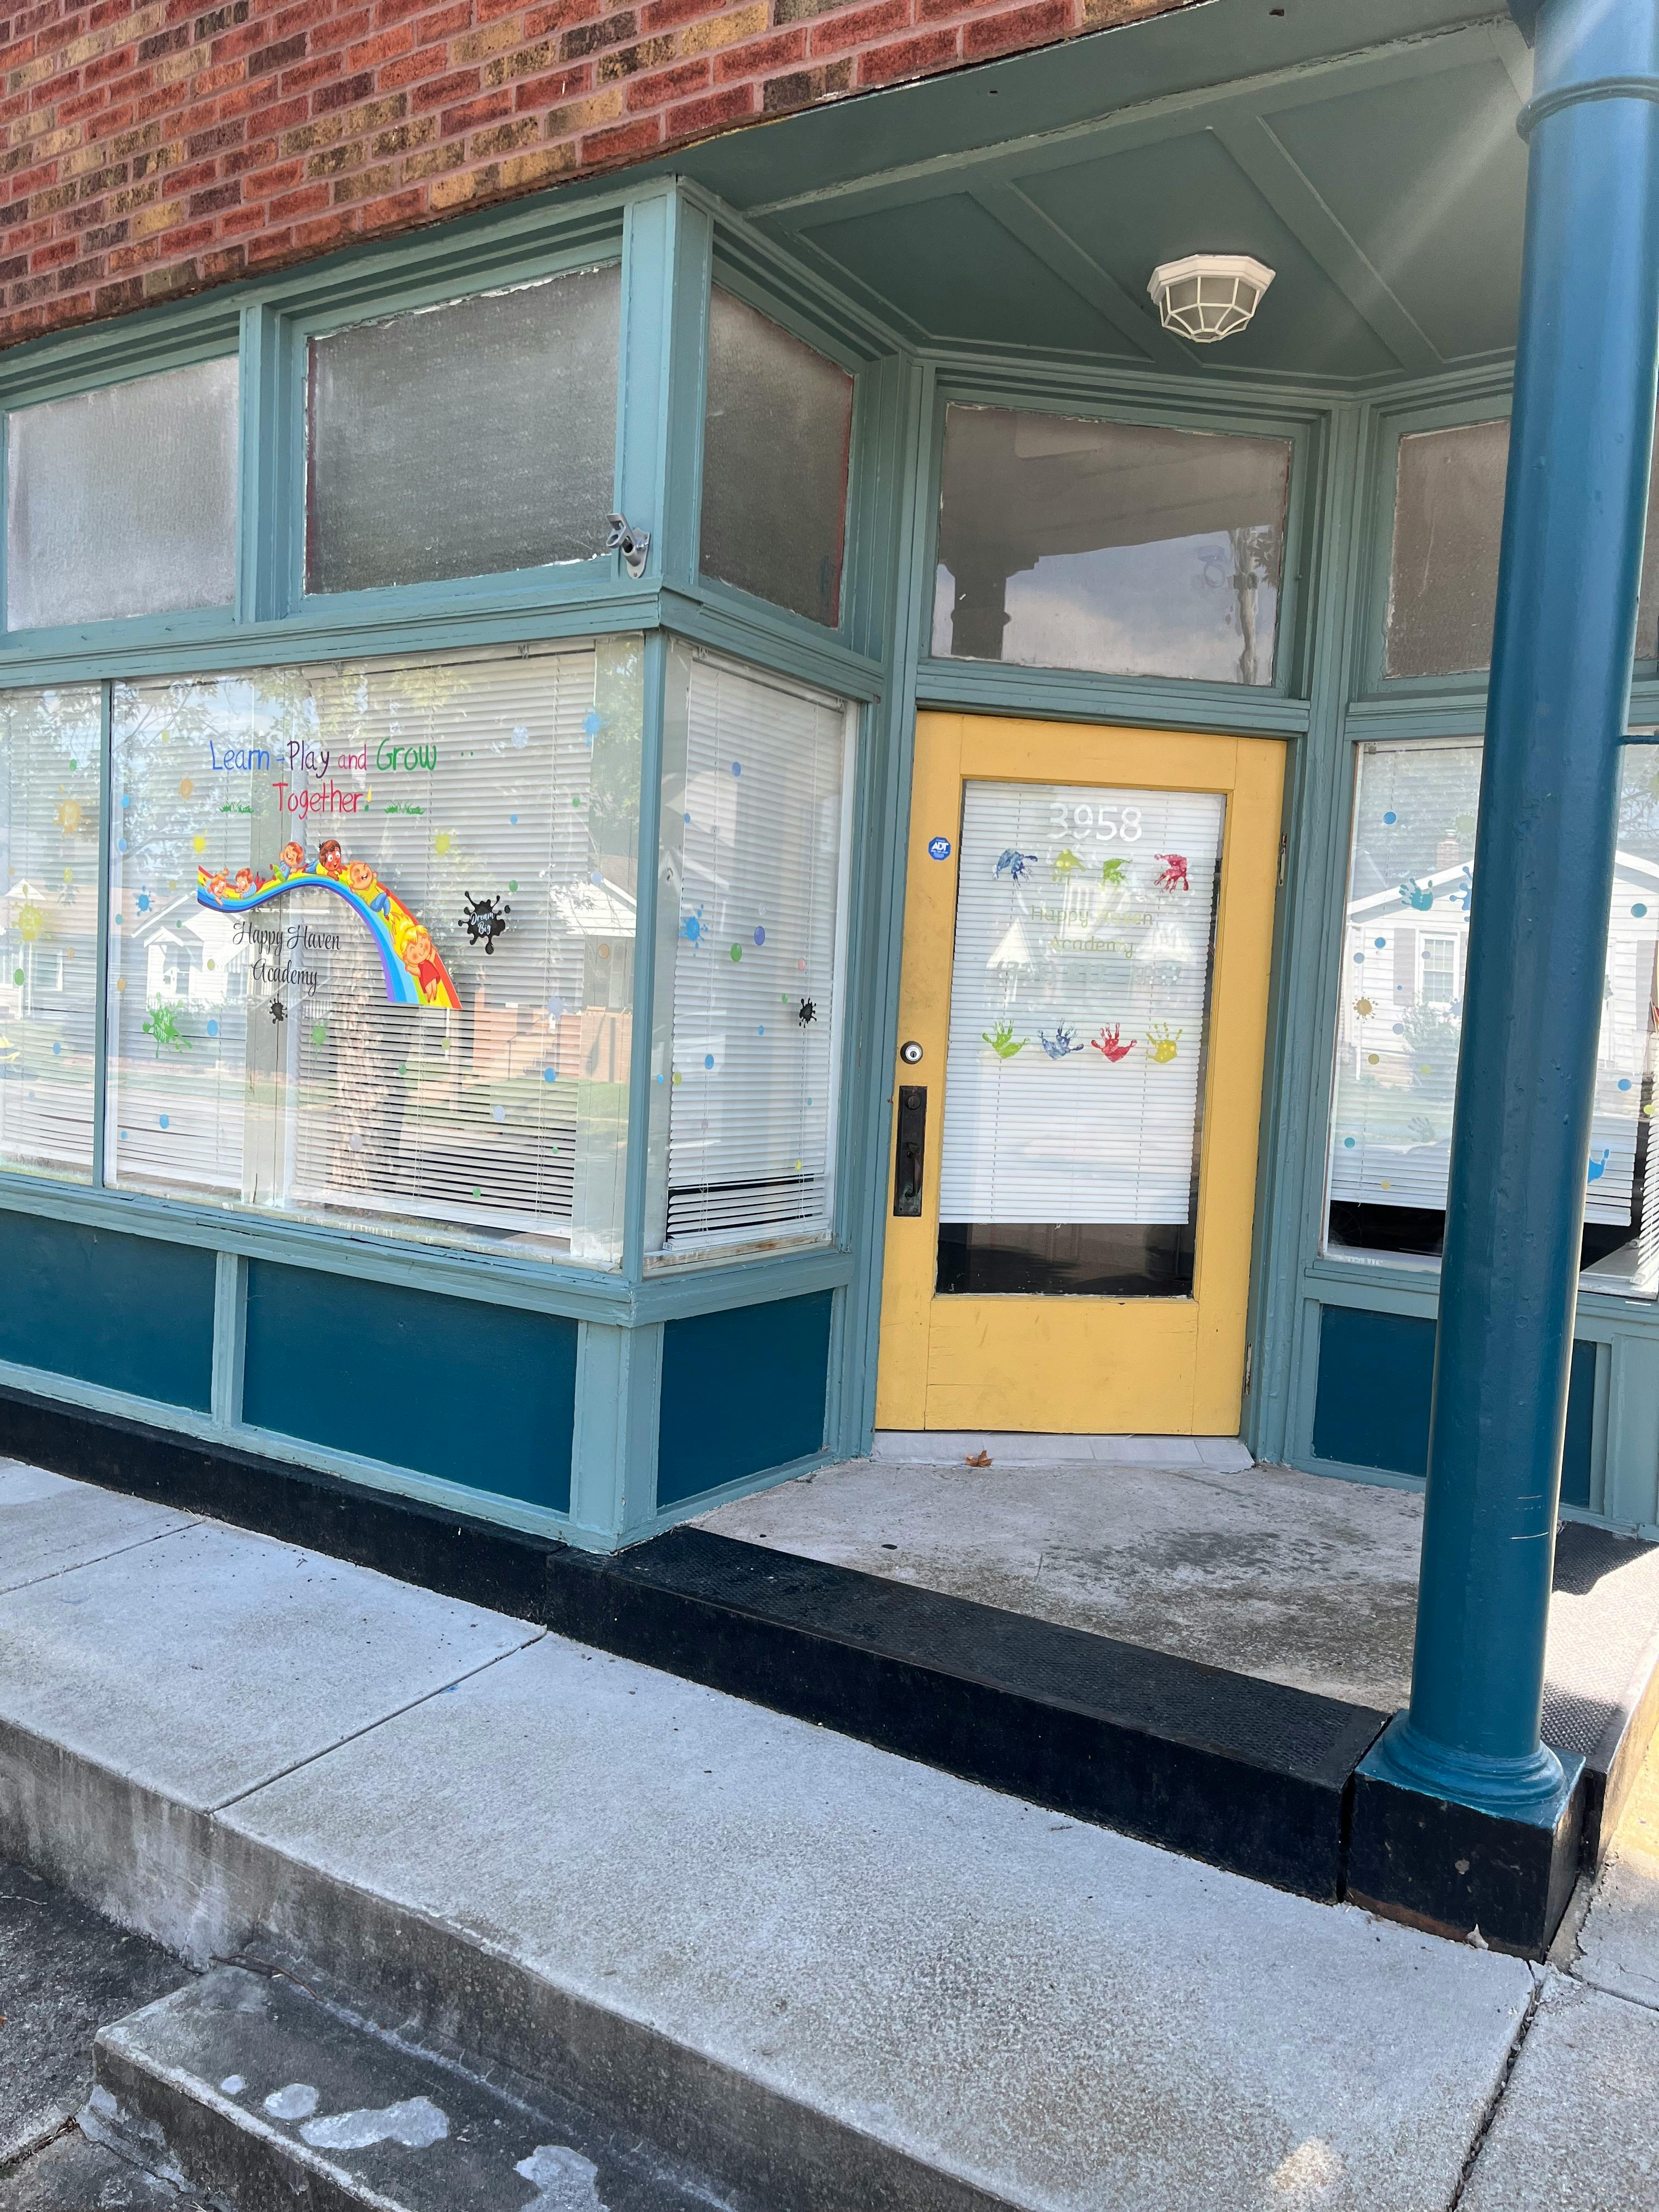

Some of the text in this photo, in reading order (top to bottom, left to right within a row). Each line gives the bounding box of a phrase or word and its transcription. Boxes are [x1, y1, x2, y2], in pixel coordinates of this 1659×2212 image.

[210, 740, 269, 771] Learn
[287, 740, 330, 778] Play
[338, 743, 367, 770] and
[376, 737, 437, 771] Grow
[272, 779, 372, 820] Together!
[1047, 802, 1142, 842] 3958
[931, 842, 949, 851] ADT
[470, 912, 494, 926] Dream
[477, 921, 491, 935] Big
[1031, 905, 1088, 928] Happy
[233, 922, 341, 957] Happy Haven
[251, 958, 318, 997] Academy
